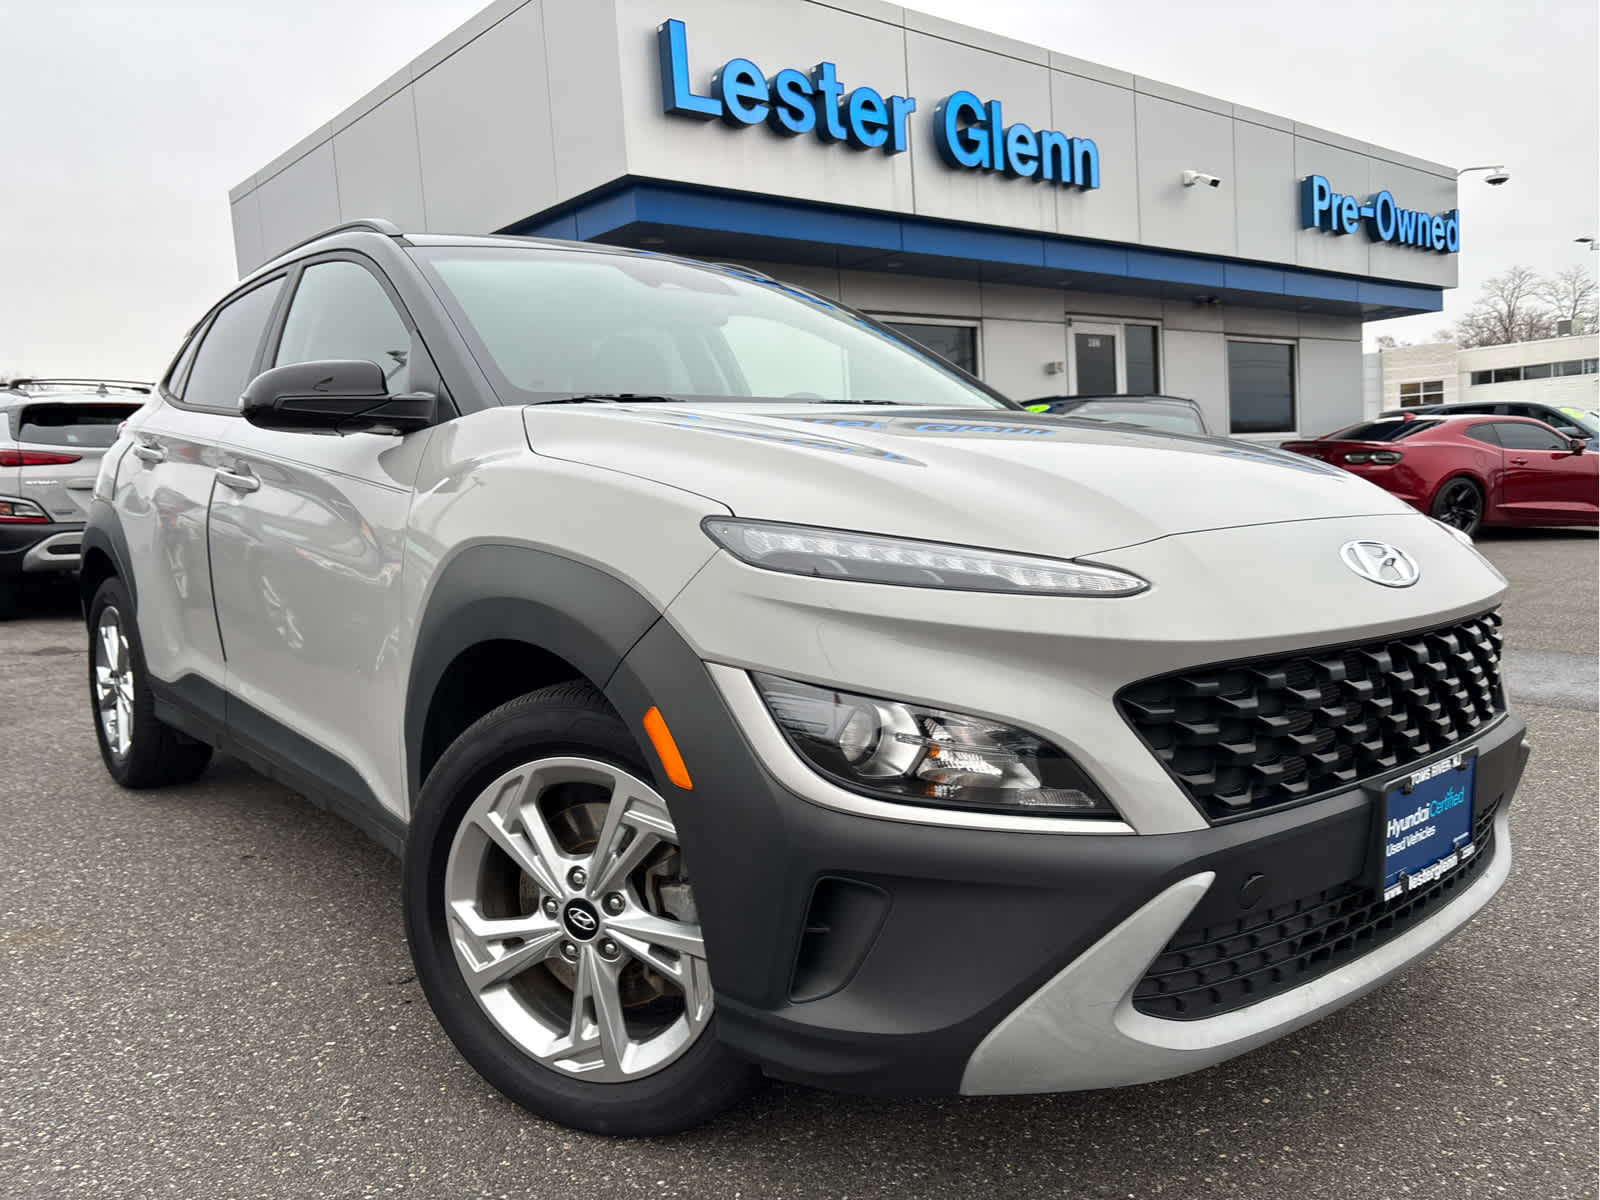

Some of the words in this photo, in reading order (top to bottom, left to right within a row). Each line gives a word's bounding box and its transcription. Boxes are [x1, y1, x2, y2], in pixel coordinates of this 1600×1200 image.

[659, 18, 916, 154] Lester
[935, 90, 1100, 190] Glenn
[1303, 175, 1459, 252] Pre-Owned
[1386, 837, 1406, 857] Used
[1405, 825, 1436, 847] Vehicles
